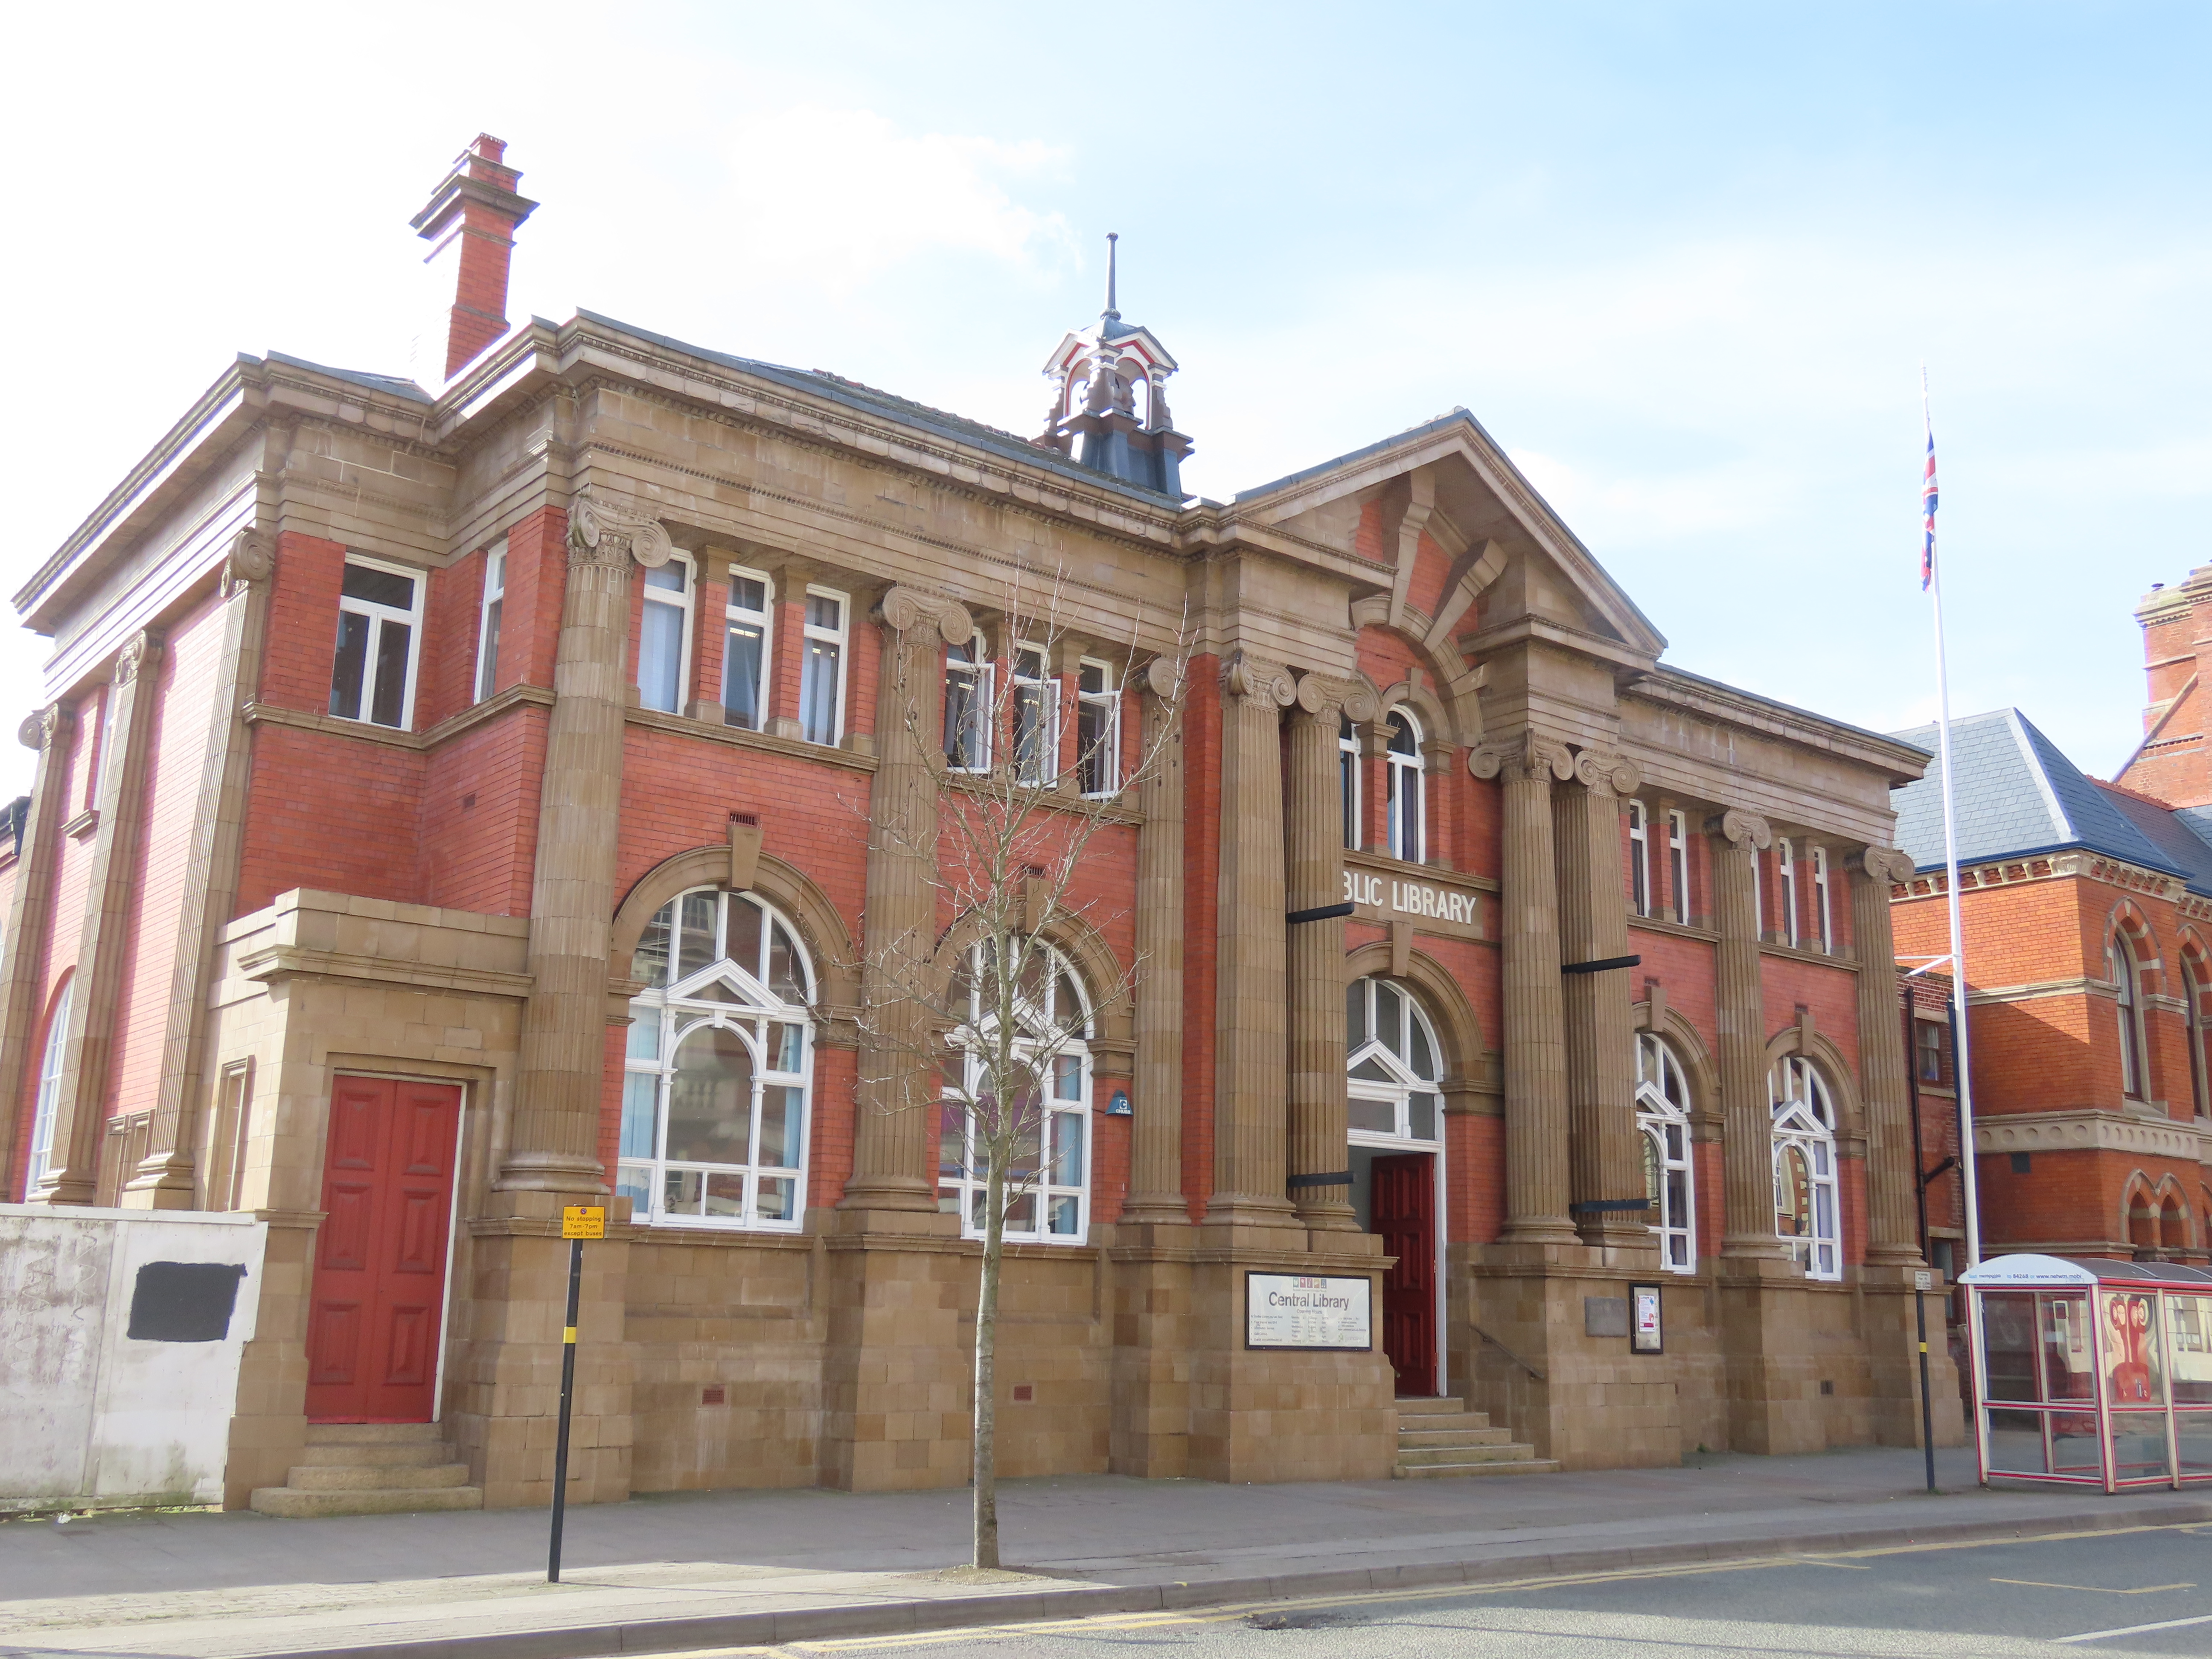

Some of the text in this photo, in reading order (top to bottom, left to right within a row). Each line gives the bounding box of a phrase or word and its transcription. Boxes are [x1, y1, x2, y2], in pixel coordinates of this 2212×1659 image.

[1392, 881, 1476, 924] LIBRARY
[1269, 1291, 1349, 1311] Central Library
